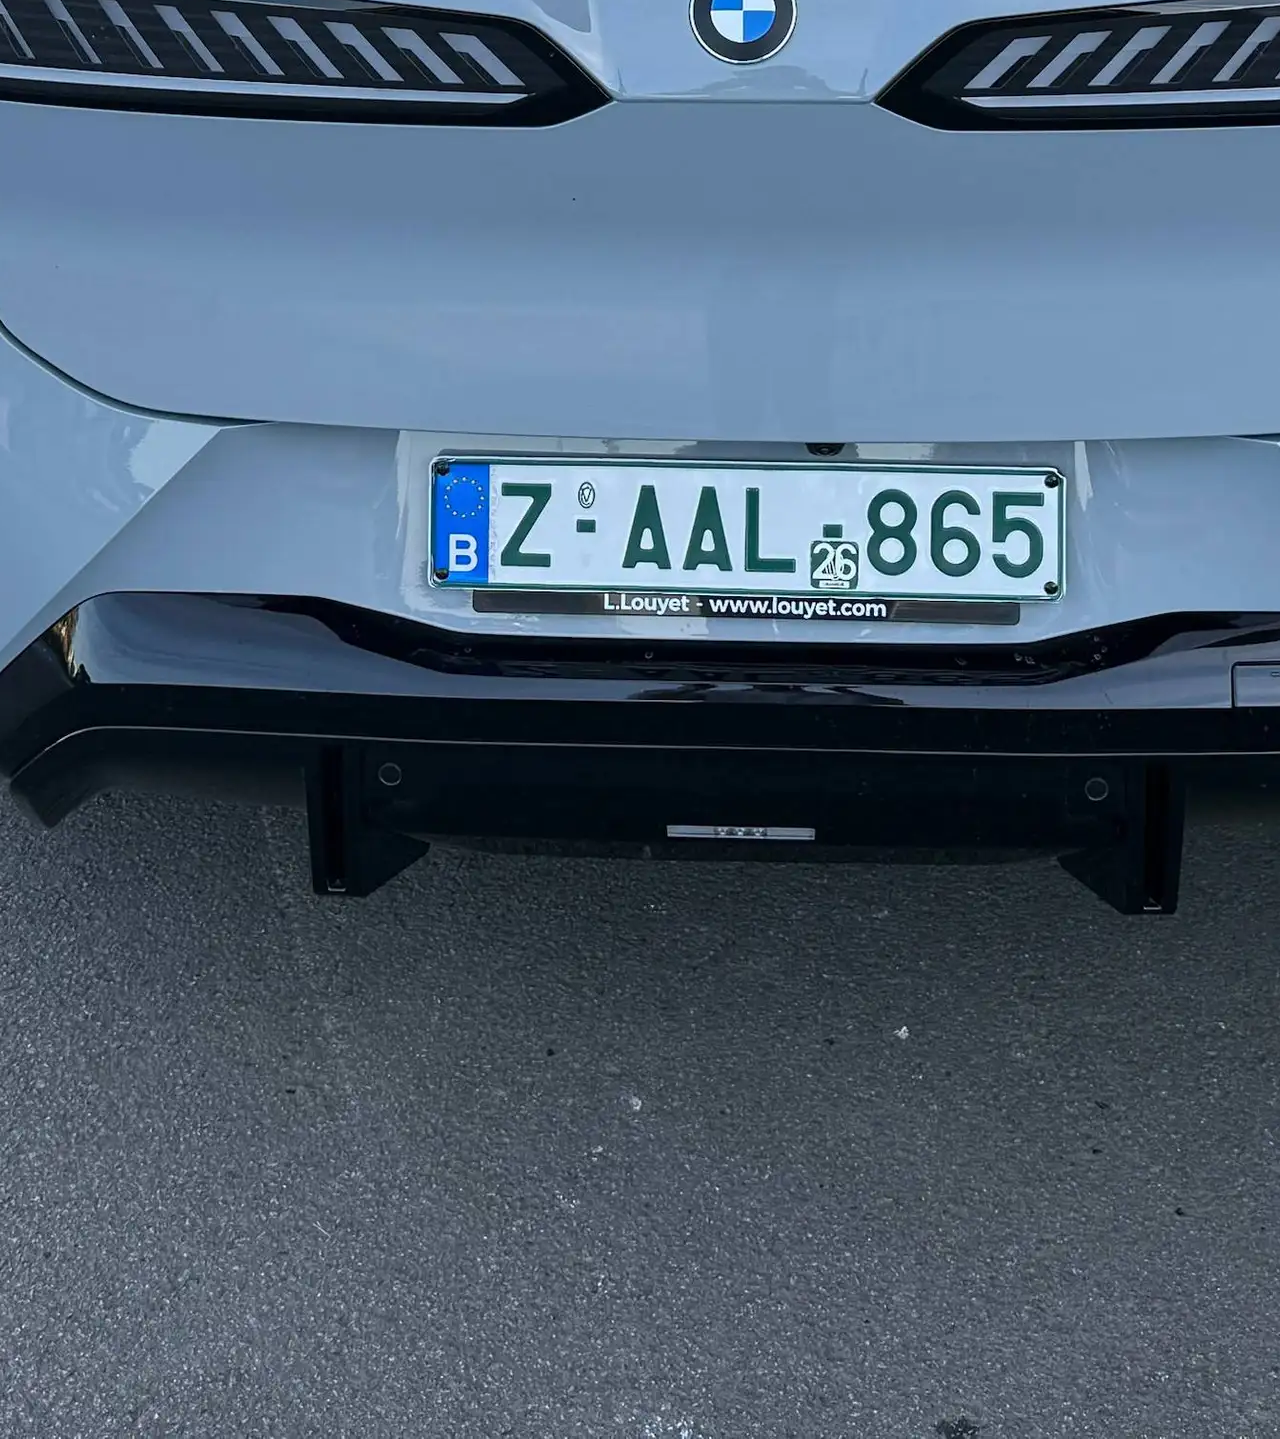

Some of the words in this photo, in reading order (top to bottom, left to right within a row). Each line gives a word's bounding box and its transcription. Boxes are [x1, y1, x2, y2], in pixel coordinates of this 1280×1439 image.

[449, 534, 478, 572] B
[812, 542, 858, 581] 26
[603, 593, 690, 616] L.Louyet
[709, 596, 887, 620] www.louyet.com
